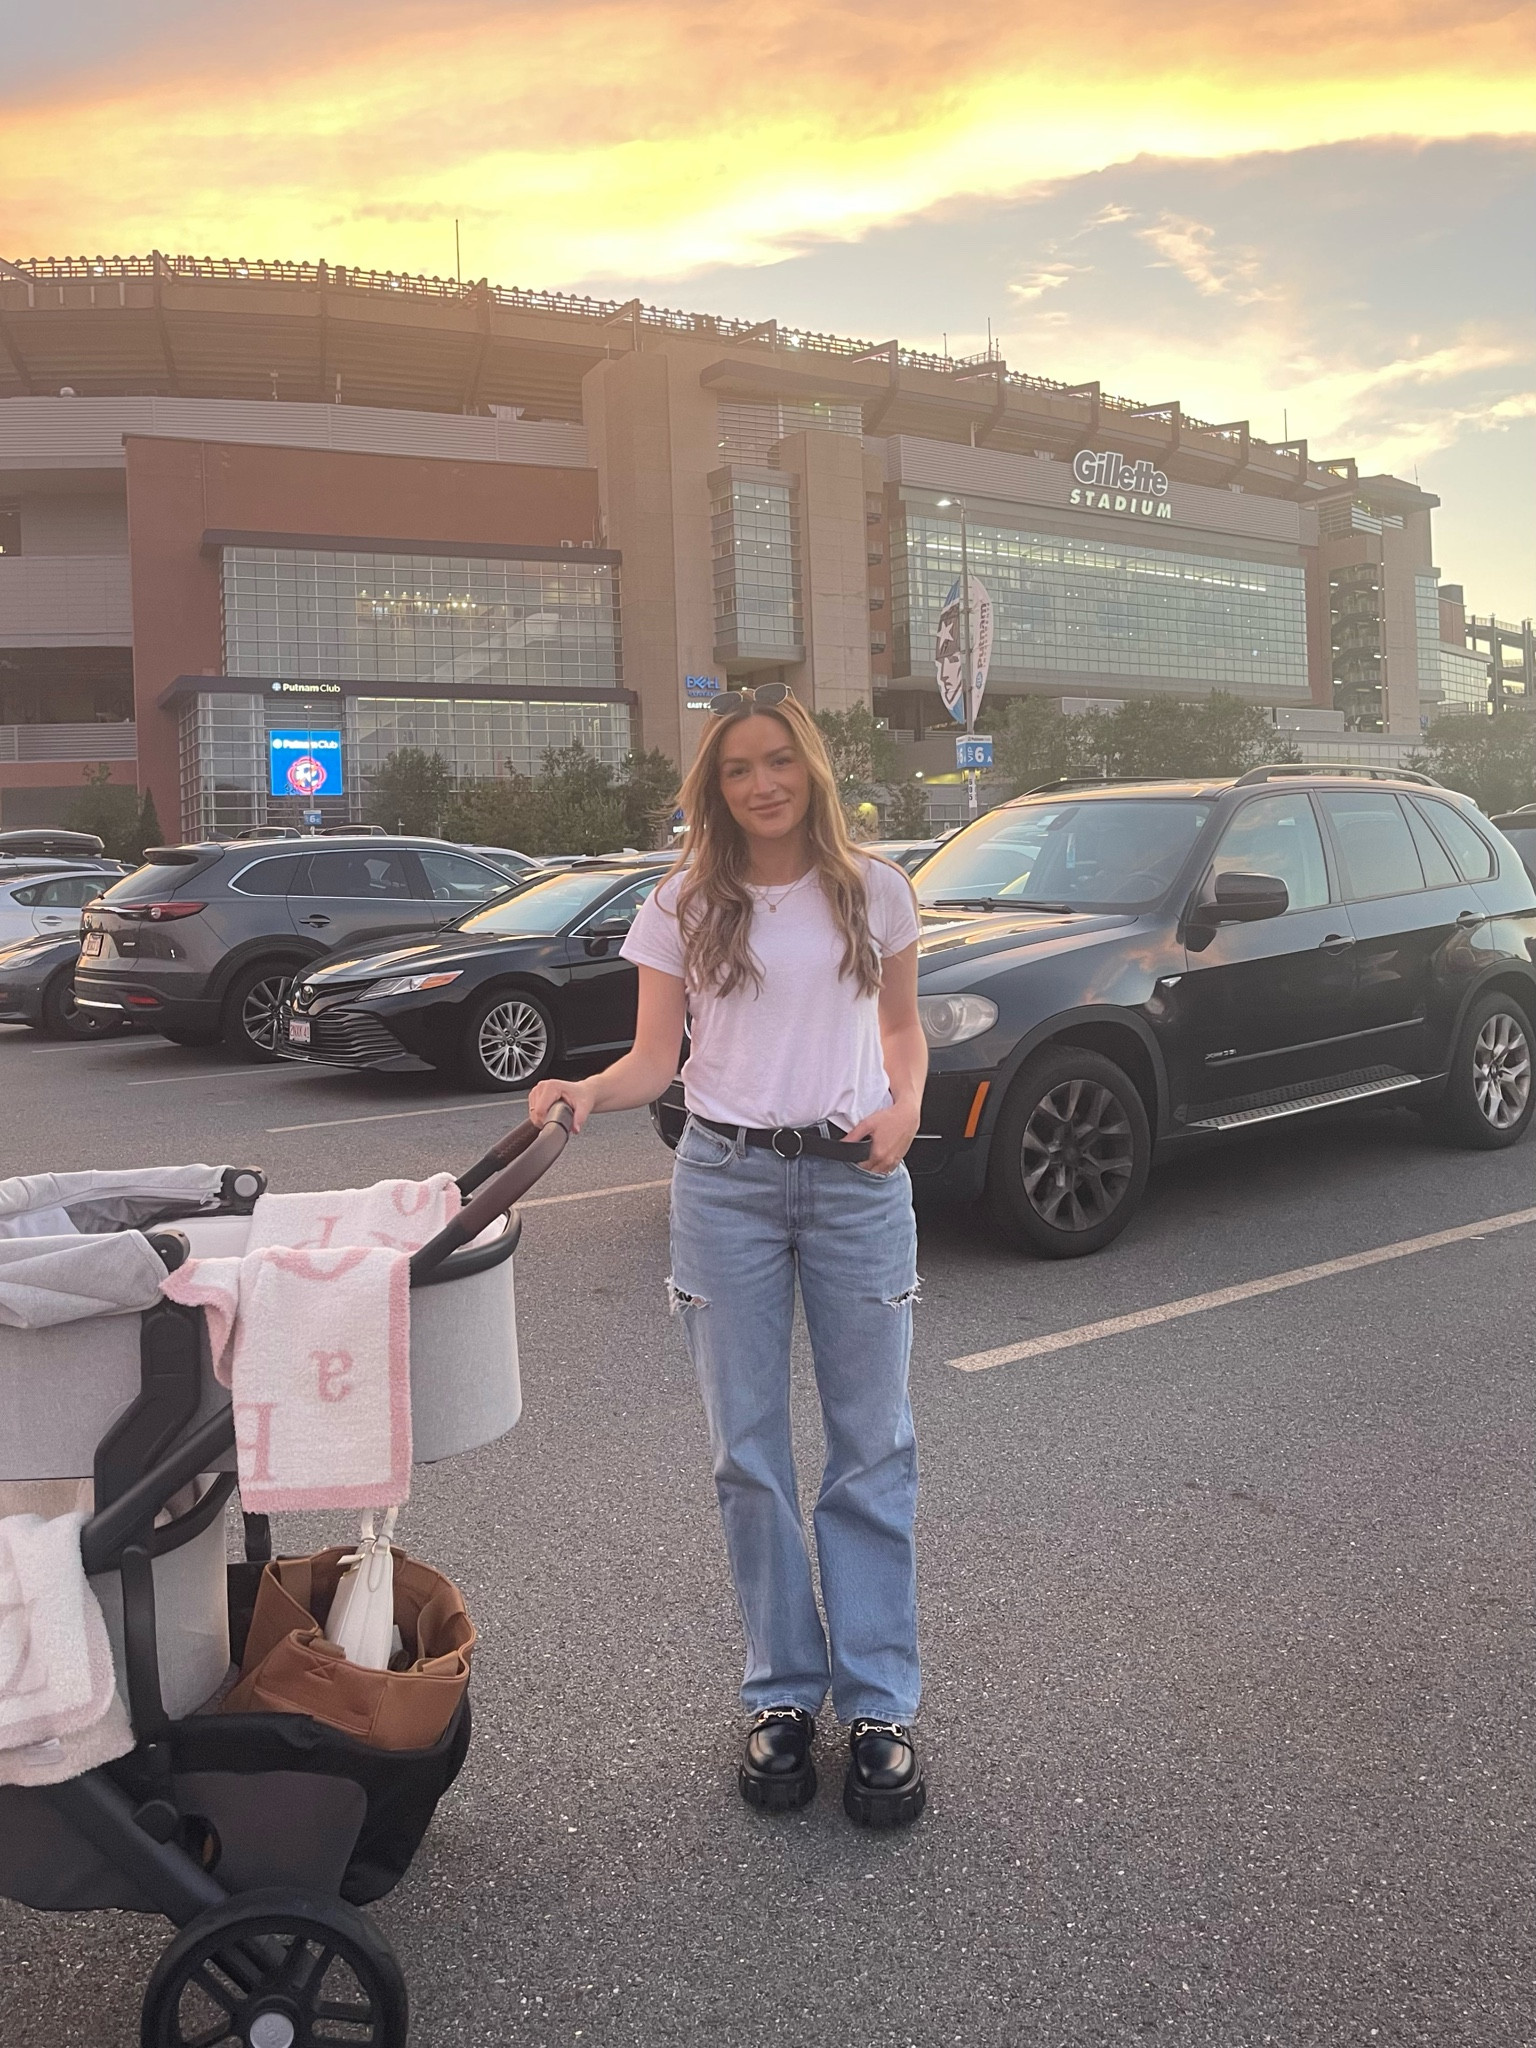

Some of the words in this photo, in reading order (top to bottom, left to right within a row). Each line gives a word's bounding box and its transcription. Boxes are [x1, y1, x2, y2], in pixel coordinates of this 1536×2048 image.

[1074, 449, 1168, 496] Gillette
[1070, 488, 1171, 519] STADIUM
[282, 683, 319, 692] Putnam
[320, 684, 341, 693] Club
[686, 675, 720, 689] DELL
[975, 747, 984, 763] 6
[309, 815, 316, 823] 6
